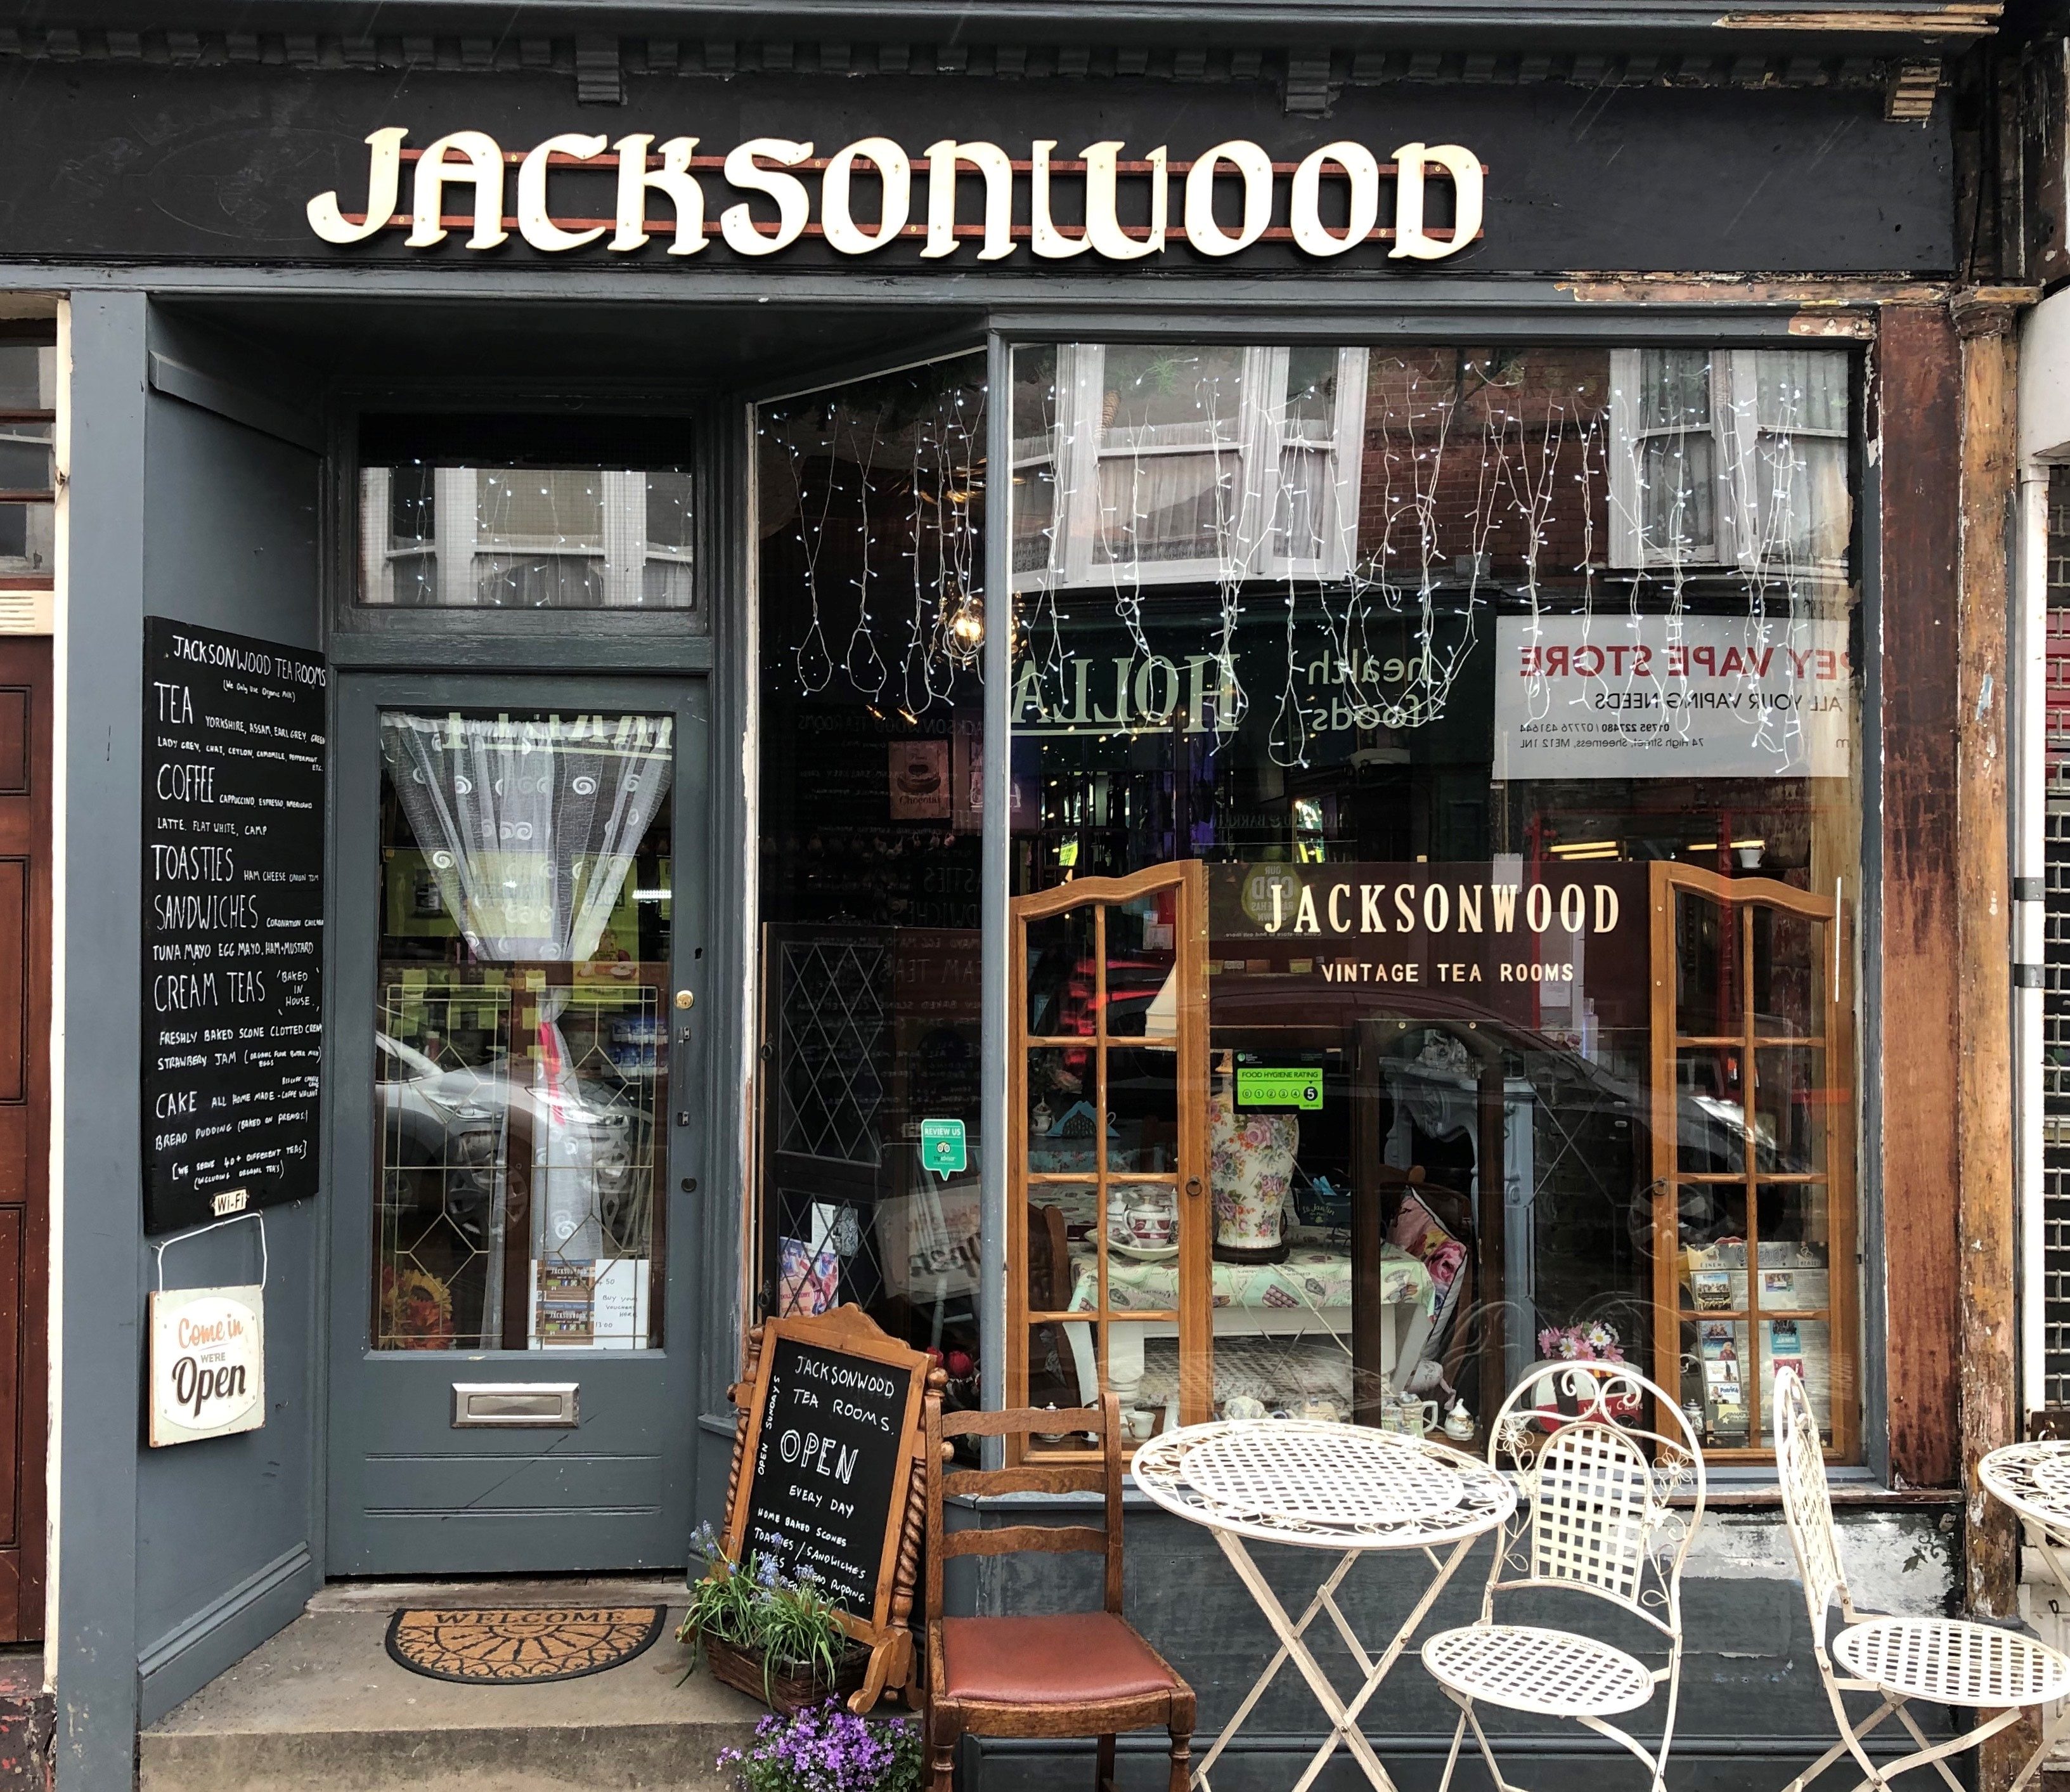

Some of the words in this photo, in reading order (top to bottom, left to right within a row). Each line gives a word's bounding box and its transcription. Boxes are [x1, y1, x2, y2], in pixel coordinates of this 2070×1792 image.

[306, 128, 1485, 261] JACKSONWOOD
[172, 635, 271, 675] JACKSONWOOD
[275, 658, 292, 679] TEA
[295, 661, 326, 687] ROOMS
[153, 682, 193, 724] TEA
[158, 736, 178, 748] LADY
[274, 727, 289, 738] EARL
[157, 763, 216, 803] COFFEE
[193, 821, 210, 833] FLAT
[245, 826, 267, 836] CAMP
[151, 845, 234, 881] TOASTIES
[243, 870, 260, 881] HAM
[262, 871, 286, 881] CHEESE
[154, 895, 258, 931] SANDWICHES
[1265, 883, 1619, 934] JACKSONWOOD
[153, 944, 181, 961] TUNA
[218, 942, 234, 956] EGG
[1321, 963, 1419, 983] VINTAGE
[1437, 963, 1482, 982] TEA
[1500, 963, 1574, 982] ROOMS
[154, 972, 218, 1011] CREAM
[226, 971, 265, 1003] TEAS
[294, 984, 303, 994] IN
[159, 1032, 198, 1046] FRESHLY
[204, 1029, 233, 1042] BAKED
[239, 1027, 264, 1039] SCONE
[270, 1024, 304, 1037] CLOTTED
[215, 1051, 236, 1065] JAM
[155, 1091, 197, 1119] CAKE
[211, 1098, 226, 1108] ALL
[233, 1093, 250, 1105] HOME
[254, 1090, 275, 1101] MADE
[1307, 1088, 1315, 1100] 5
[155, 1133, 188, 1150] BREAD
[195, 1124, 232, 1139] PUDDING
[246, 1149, 281, 1162] DIFFERENT
[217, 1192, 245, 1212] Wi-Fi
[179, 1318, 224, 1349] Come
[228, 1314, 244, 1339] in
[171, 1356, 246, 1420] Open
[794, 1355, 895, 1399] JACKSONWOOD
[793, 1389, 818, 1408] TEA
[758, 1443, 768, 1476] OPEN
[765, 1375, 780, 1429] SUNDAYS
[780, 1429, 858, 1484] OPEN
[789, 1485, 823, 1508] EVERY
[830, 1498, 854, 1519] DAY
[758, 1507, 780, 1523] HOME
[785, 1516, 810, 1533] BAKED
[816, 1527, 847, 1547] SCONES
[434, 1611, 626, 1624] WELCOME
